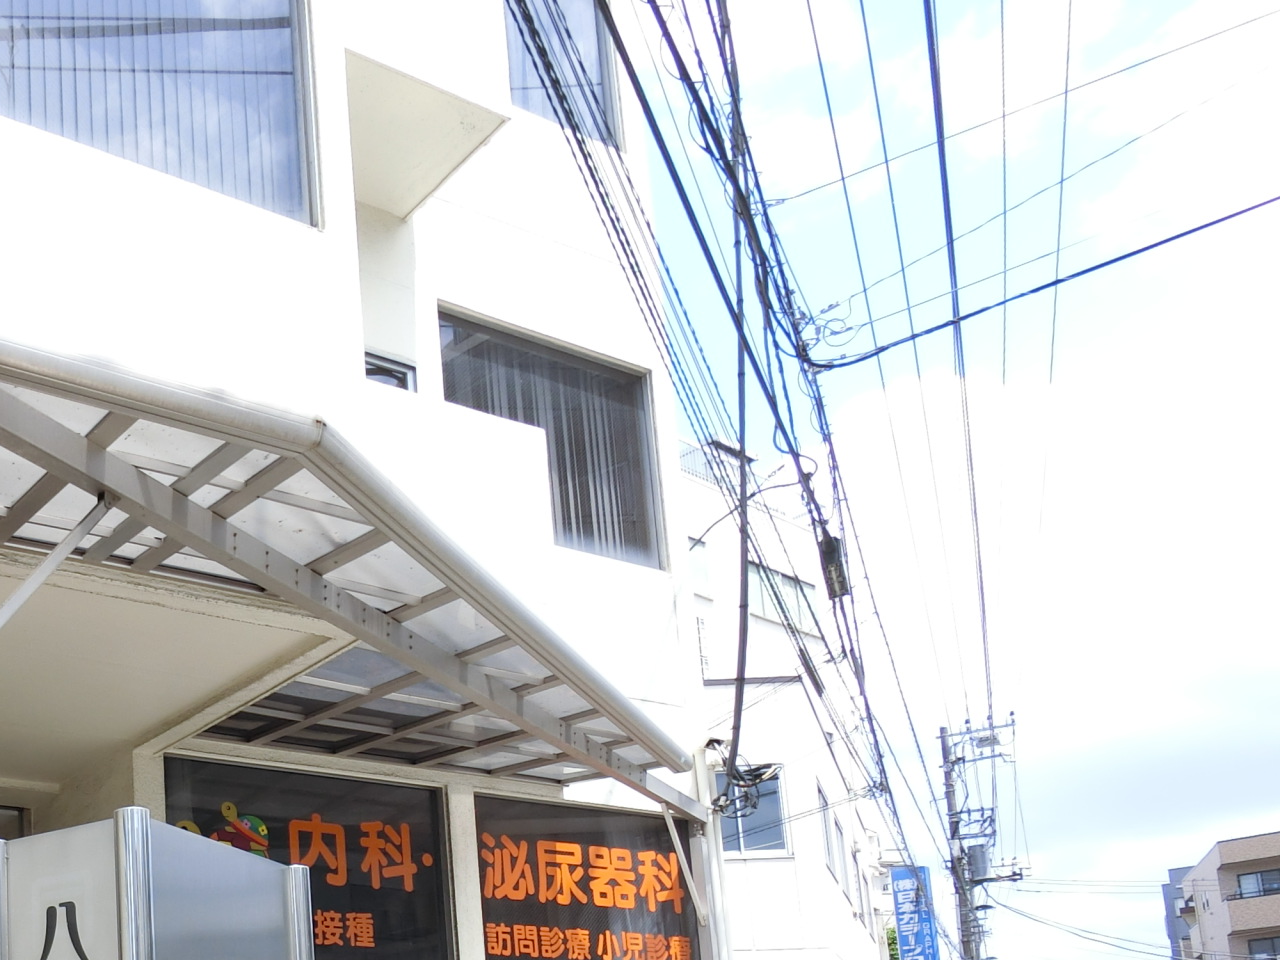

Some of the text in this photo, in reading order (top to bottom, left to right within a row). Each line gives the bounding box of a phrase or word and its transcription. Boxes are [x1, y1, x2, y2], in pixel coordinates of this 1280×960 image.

[481, 832, 684, 914] 泌尿器科
[486, 923, 591, 960] 訪問診療
